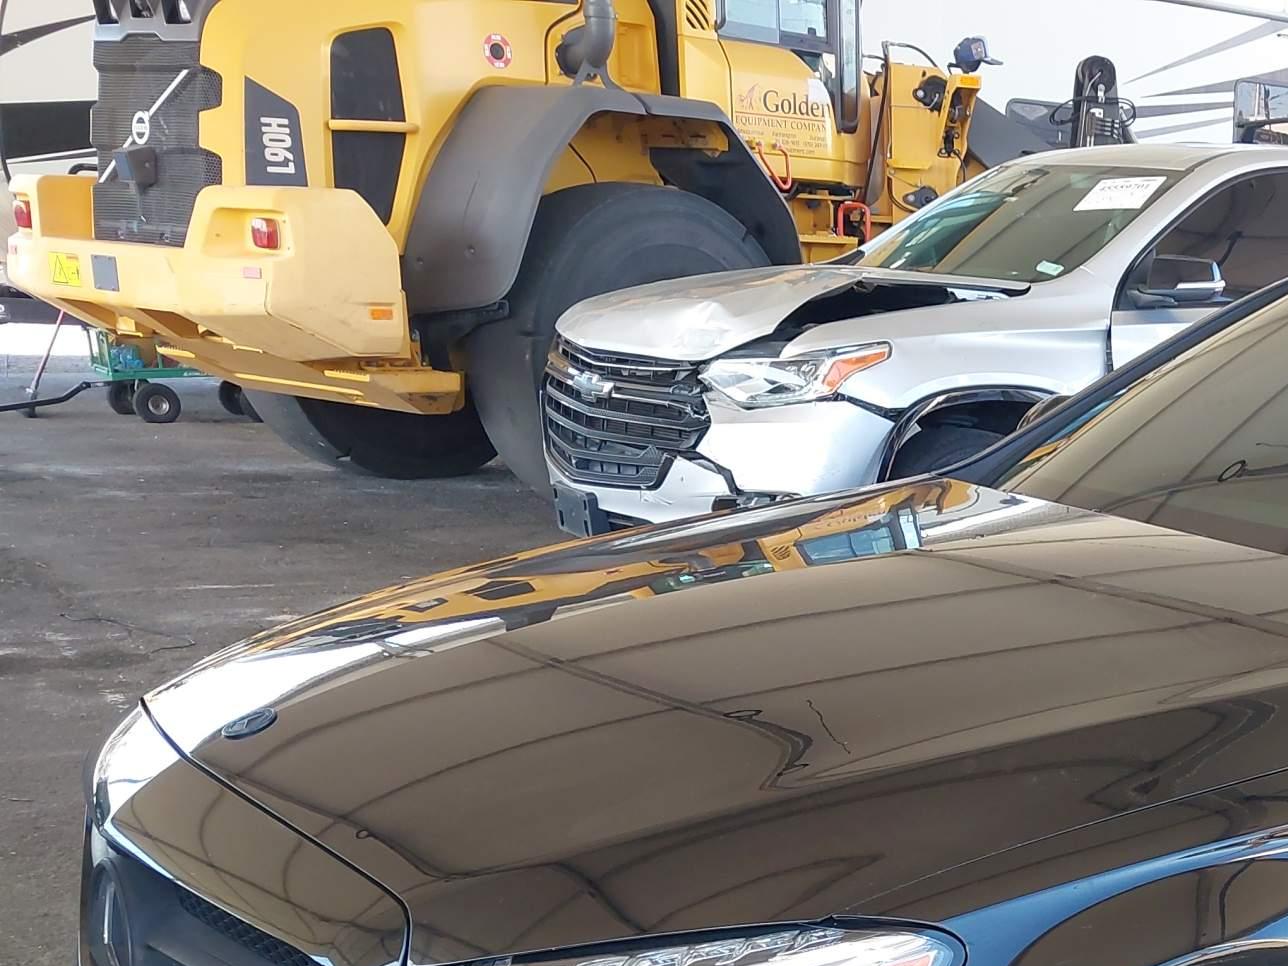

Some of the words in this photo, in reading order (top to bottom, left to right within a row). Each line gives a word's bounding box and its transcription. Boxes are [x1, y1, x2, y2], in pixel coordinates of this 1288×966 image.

[762, 89, 831, 118] Golden
[735, 115, 788, 128] EQUIPMENT
[790, 120, 827, 134] COMPAN
[260, 116, 296, 175] L90H
